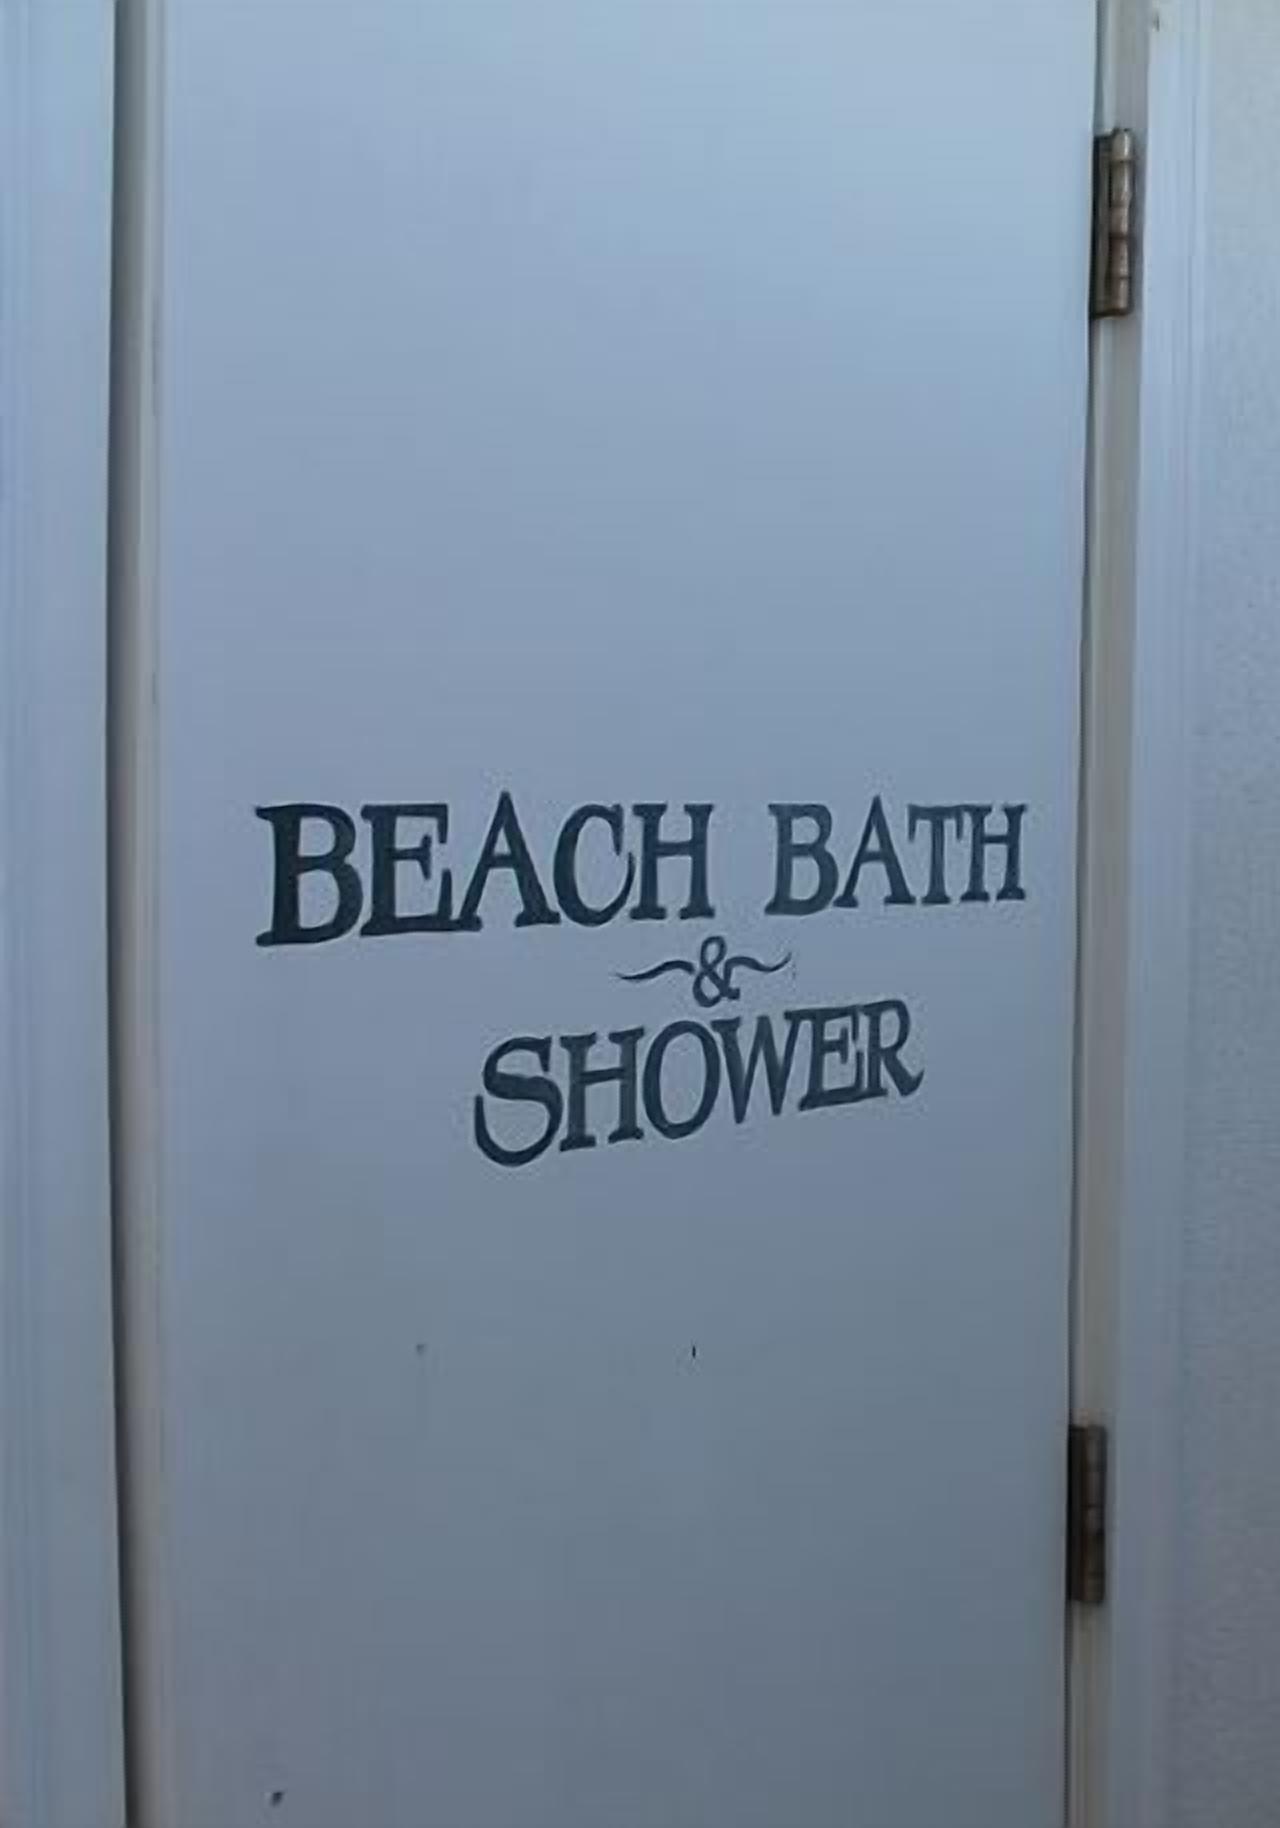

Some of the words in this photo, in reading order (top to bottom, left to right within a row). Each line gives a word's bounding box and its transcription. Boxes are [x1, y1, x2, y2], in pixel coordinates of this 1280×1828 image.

[255, 790, 717, 948] BEACH
[763, 795, 1029, 917] BATH
[692, 935, 741, 1008] &
[473, 998, 925, 1168] SHOWER
